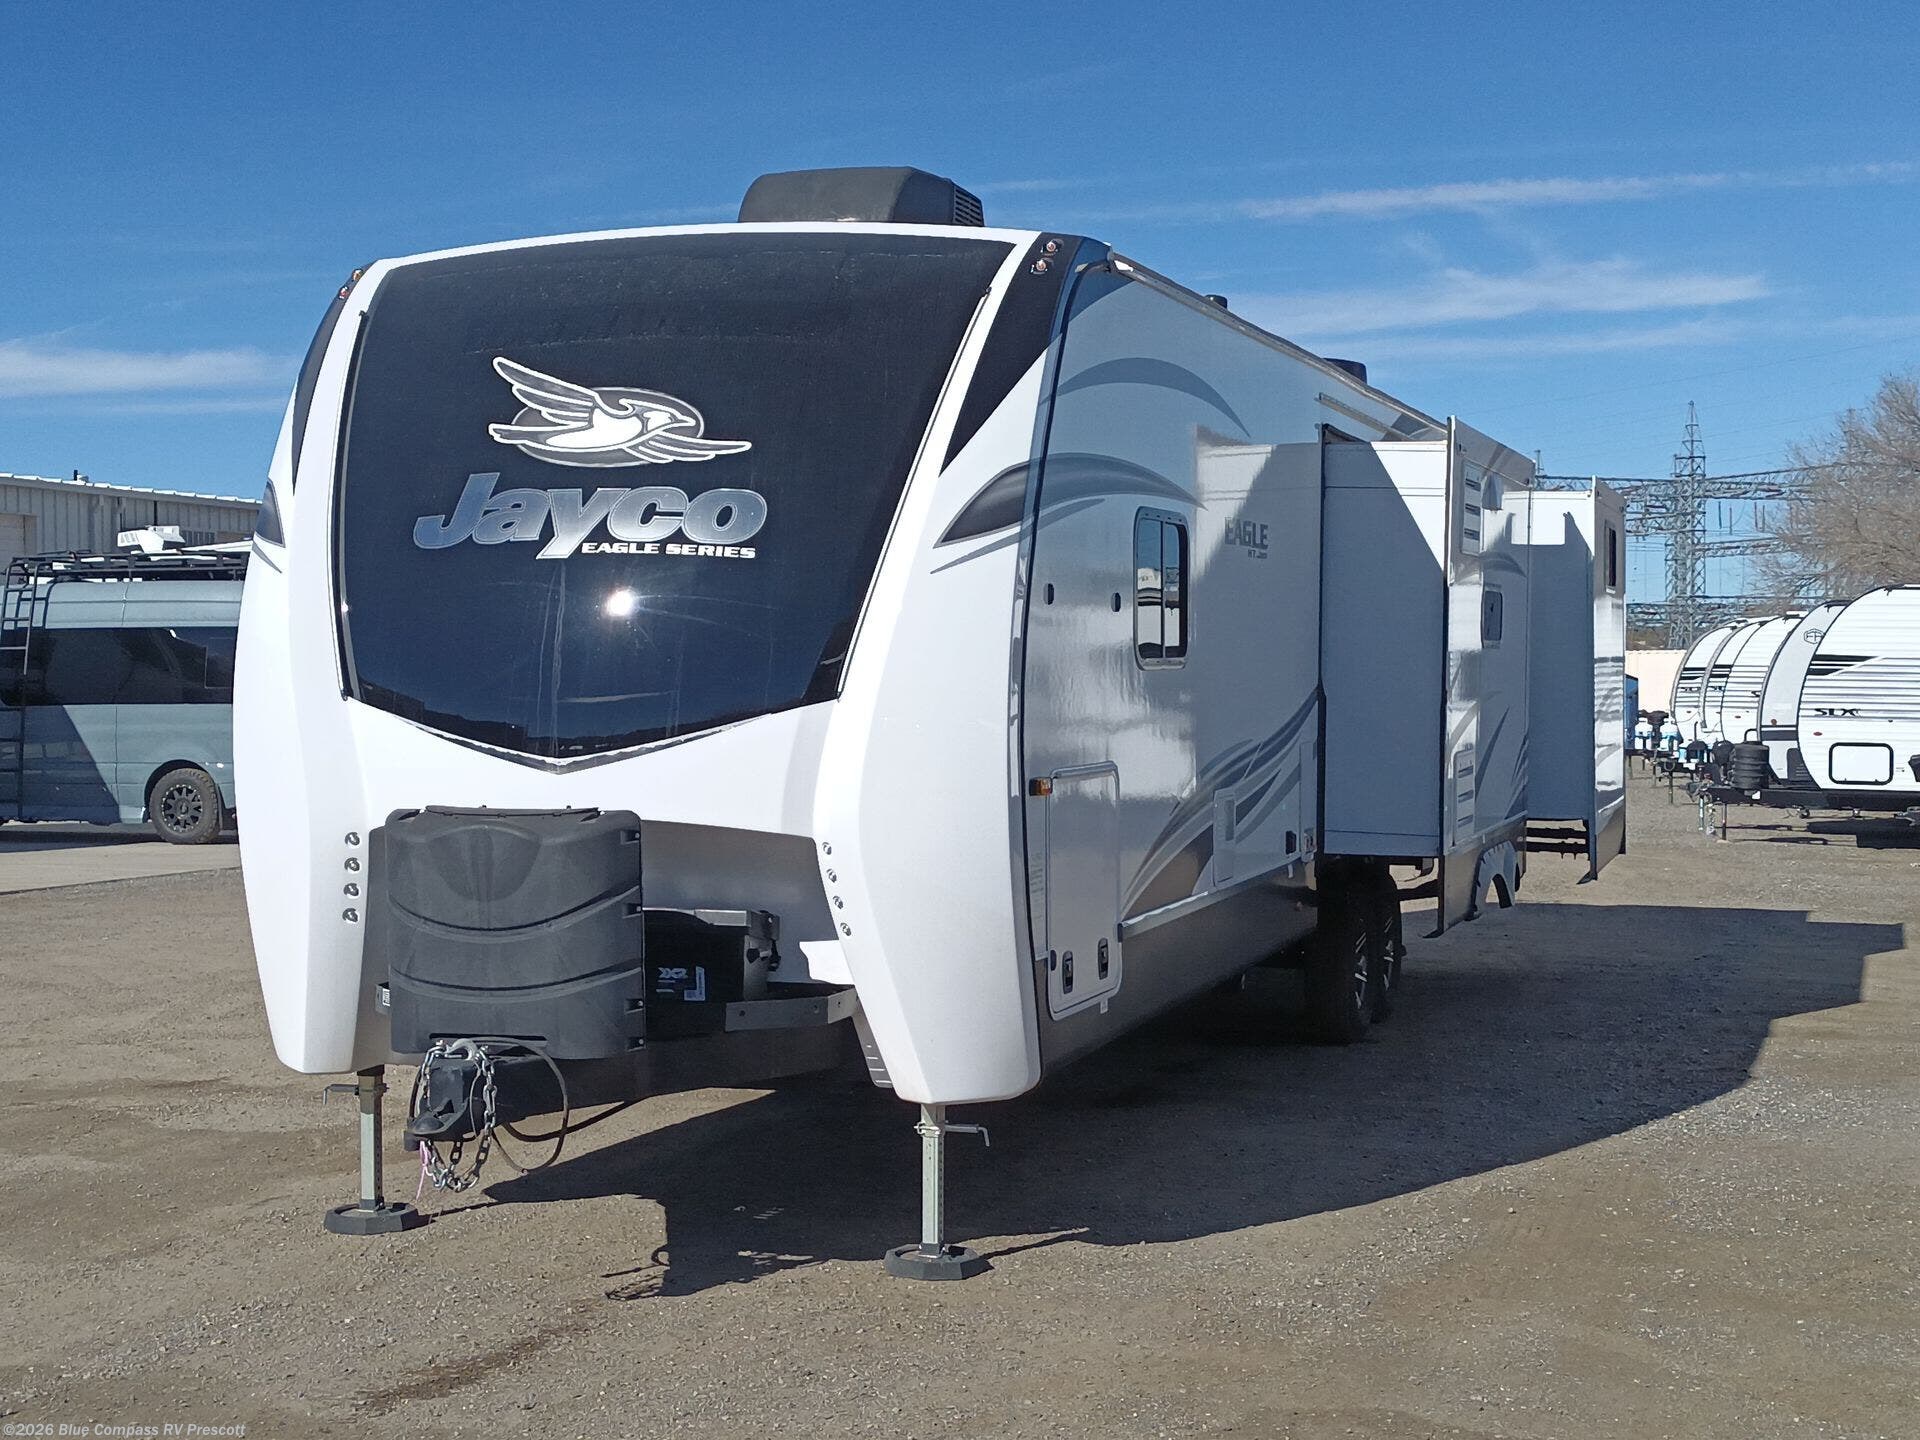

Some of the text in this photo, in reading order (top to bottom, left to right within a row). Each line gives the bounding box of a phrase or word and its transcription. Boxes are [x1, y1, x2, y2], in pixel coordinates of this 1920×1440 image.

[413, 472, 768, 560] Jayco
[1224, 517, 1269, 550] EAGLE
[581, 542, 756, 559] EAGLE SERIES
[1814, 707, 1859, 718] SLX
